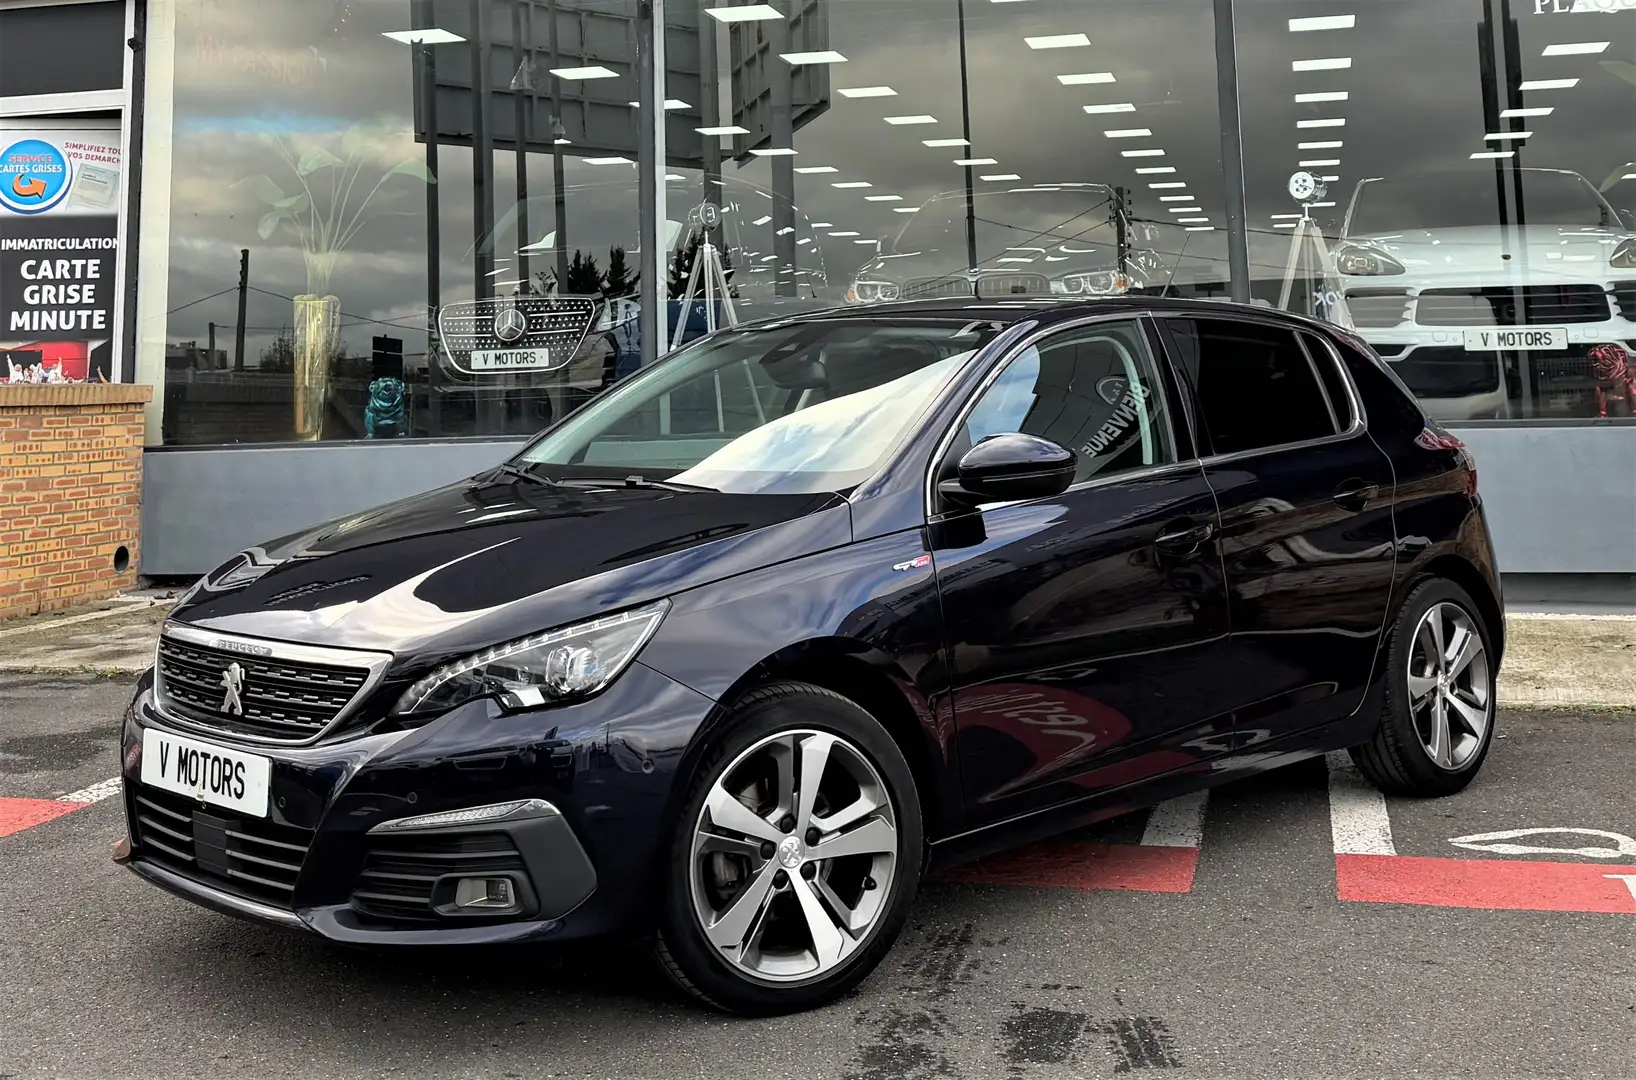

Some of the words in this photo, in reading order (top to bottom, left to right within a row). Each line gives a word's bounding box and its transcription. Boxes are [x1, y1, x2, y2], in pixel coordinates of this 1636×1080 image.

[64, 142, 106, 153] SIMPLIFIEZ
[9, 154, 53, 163] SERVICE
[67, 151, 83, 160] VOS
[32, 164, 63, 173] GRISES
[20, 259, 101, 280] CARTE
[23, 284, 96, 305] GRISE
[10, 309, 106, 331] MINUTE
[1480, 332, 1489, 347] V
[1497, 331, 1553, 347] MOTORS
[482, 353, 489, 365] V
[494, 351, 537, 366] MOTORS
[160, 740, 170, 779] V
[177, 745, 246, 800] MOTORS
